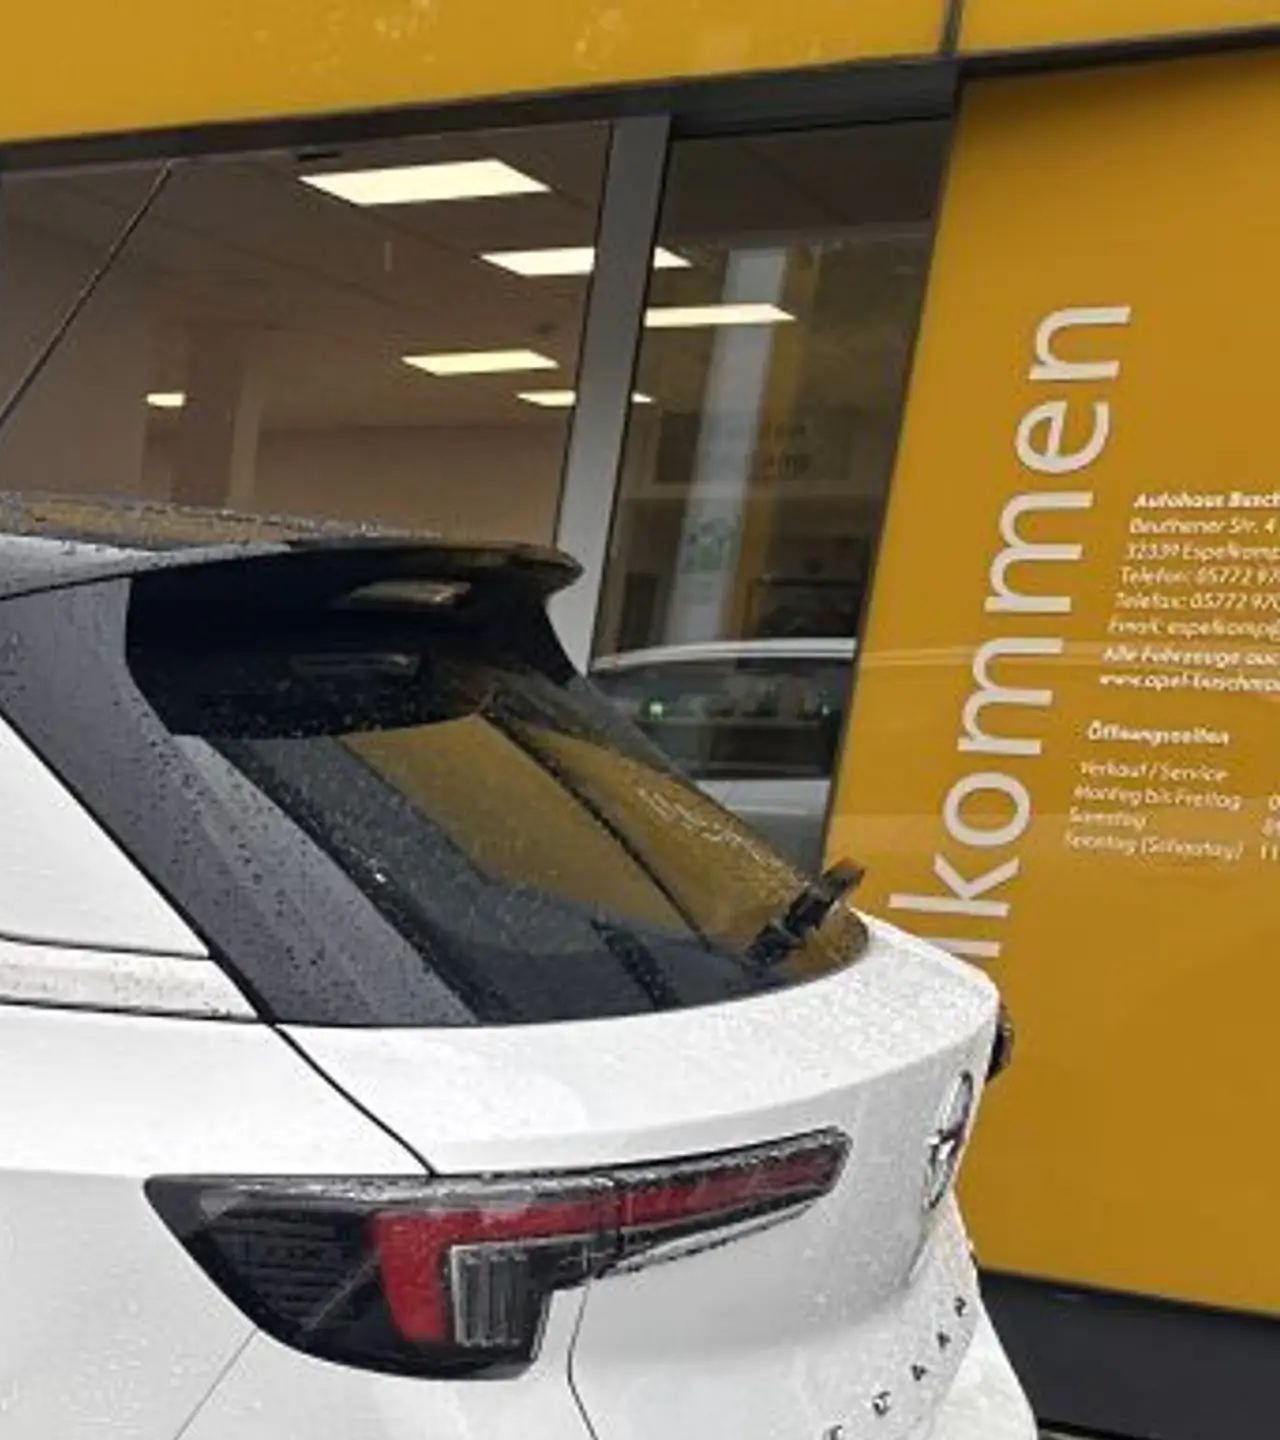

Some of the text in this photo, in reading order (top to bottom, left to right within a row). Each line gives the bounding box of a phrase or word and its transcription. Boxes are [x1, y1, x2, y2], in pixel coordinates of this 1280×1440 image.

[1133, 491, 1225, 509] Autohaus
[1088, 719, 1230, 747] Öffnungszeiten
[1080, 760, 1148, 778] Verkauf
[1159, 763, 1229, 782] Service
